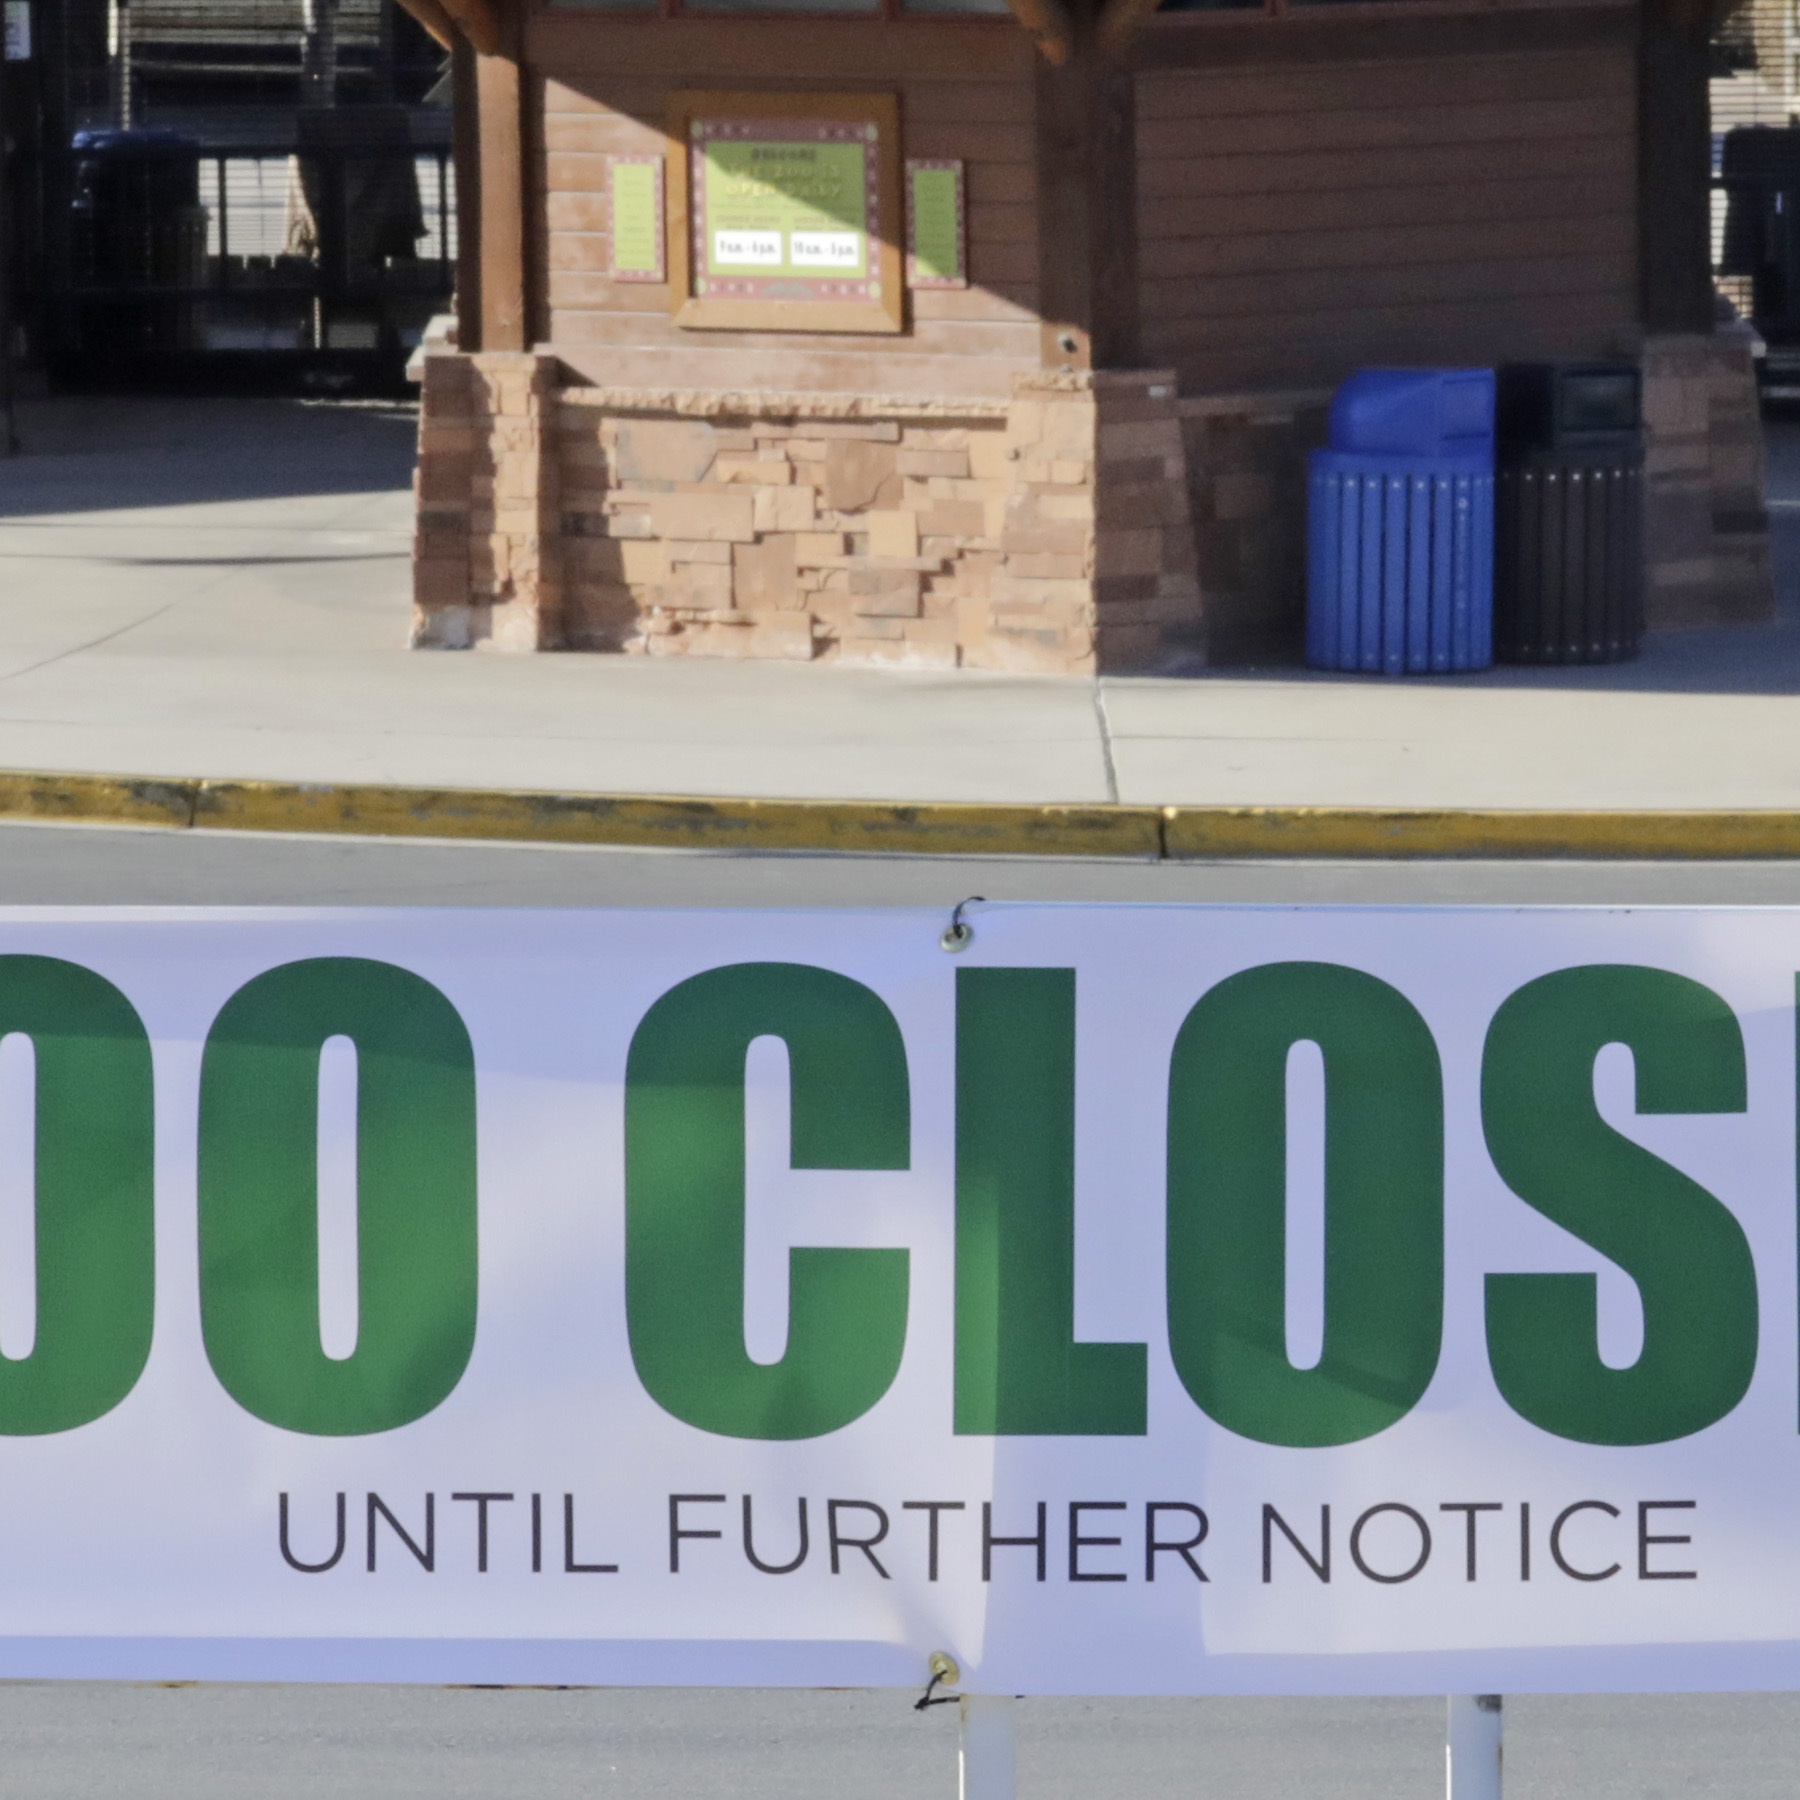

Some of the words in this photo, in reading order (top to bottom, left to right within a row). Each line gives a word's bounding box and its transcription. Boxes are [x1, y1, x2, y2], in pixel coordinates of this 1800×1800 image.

[279, 1491, 618, 1573] UNTIL
[668, 1494, 1209, 1582] FURTHER
[1262, 1499, 1696, 1584] NOTICE
